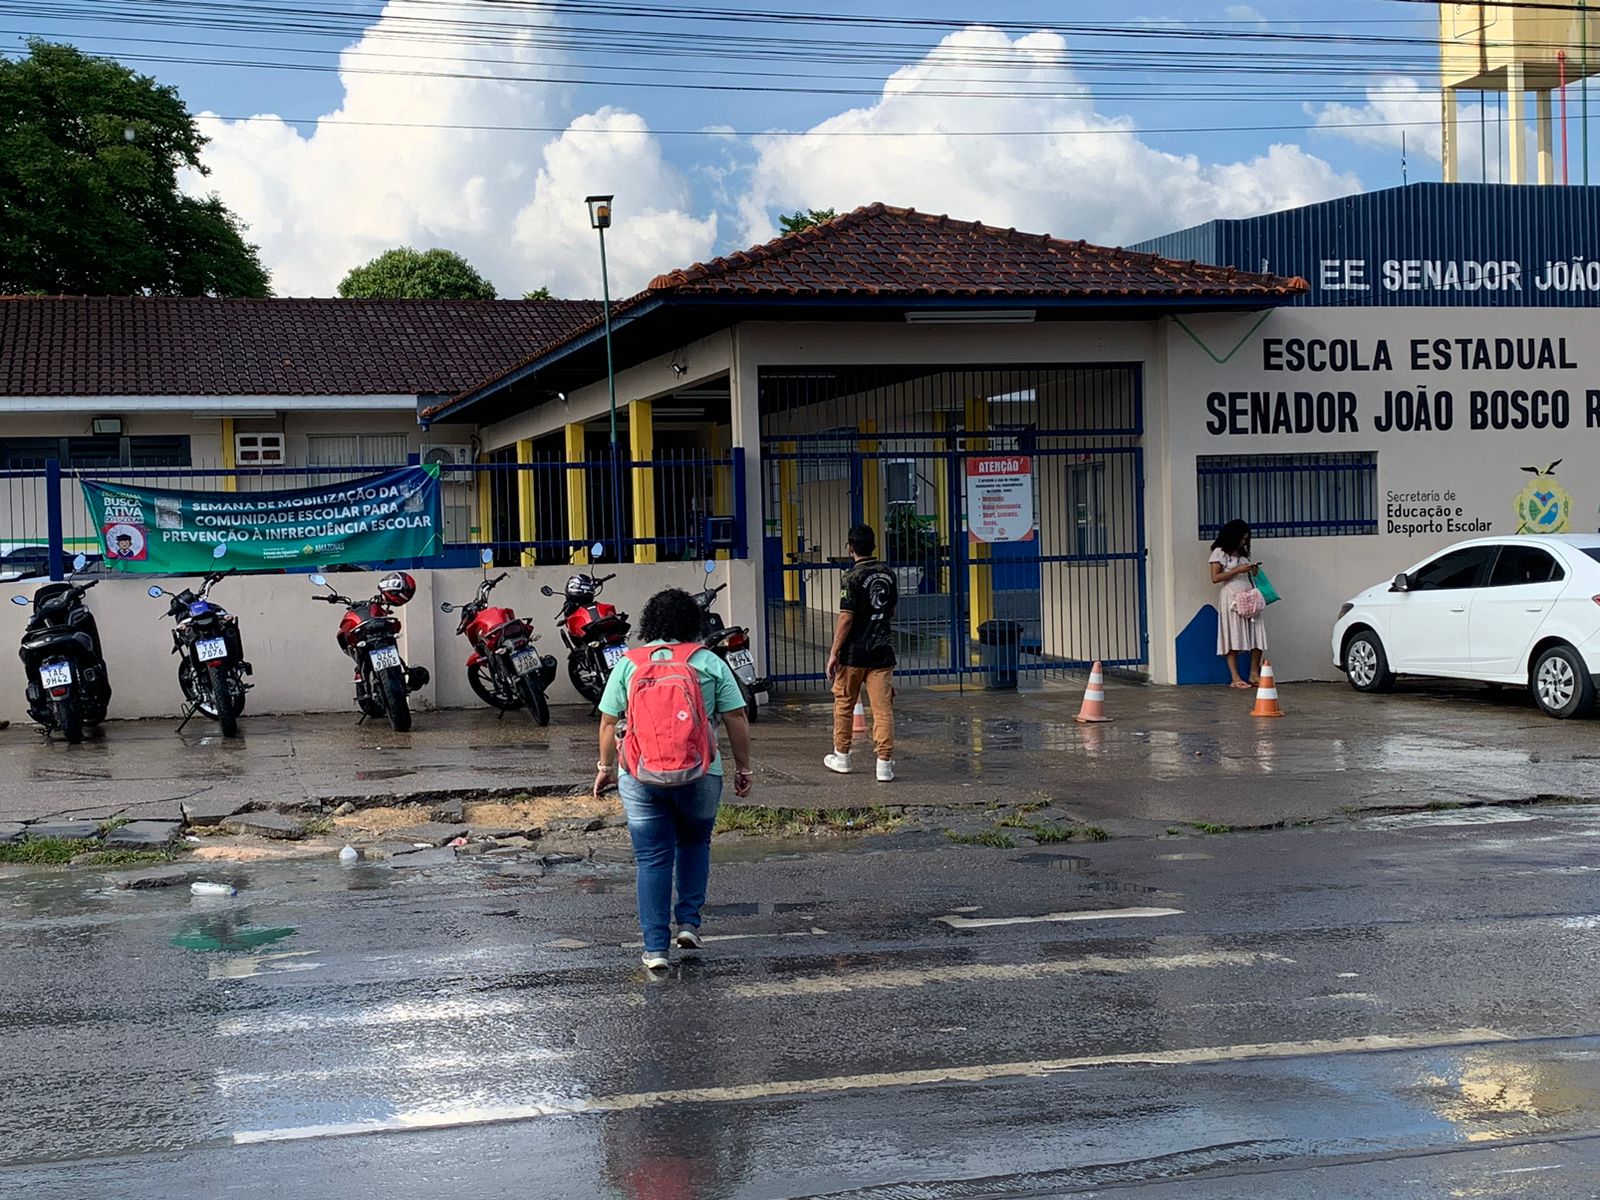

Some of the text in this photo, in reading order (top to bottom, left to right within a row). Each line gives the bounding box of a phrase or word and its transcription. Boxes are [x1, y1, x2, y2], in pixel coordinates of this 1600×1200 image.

[1320, 255, 1600, 291] E.E. SENADOR JOÃO
[1262, 337, 1578, 372] ESCOLA ESTADUAL
[1206, 391, 1359, 435] SENADOR
[1374, 384, 1453, 432] JOÃO
[1470, 389, 1570, 430] BOSCO
[978, 459, 1019, 474] ATENÇÃO
[103, 498, 143, 507] BUSCA
[192, 485, 399, 511] SEMANA DE MOBILIZAÇÃO DA
[1387, 489, 1456, 502] Secretaria de
[104, 507, 144, 517] ATIVA
[195, 502, 399, 526] COMUNIDADE ESCOLAR PARA
[1387, 503, 1463, 518] Educação e
[162, 515, 432, 543] PREVENÇÃO À INFREQUÊNCIA ESCOLAR
[1387, 517, 1492, 538] Desporto Escolar
